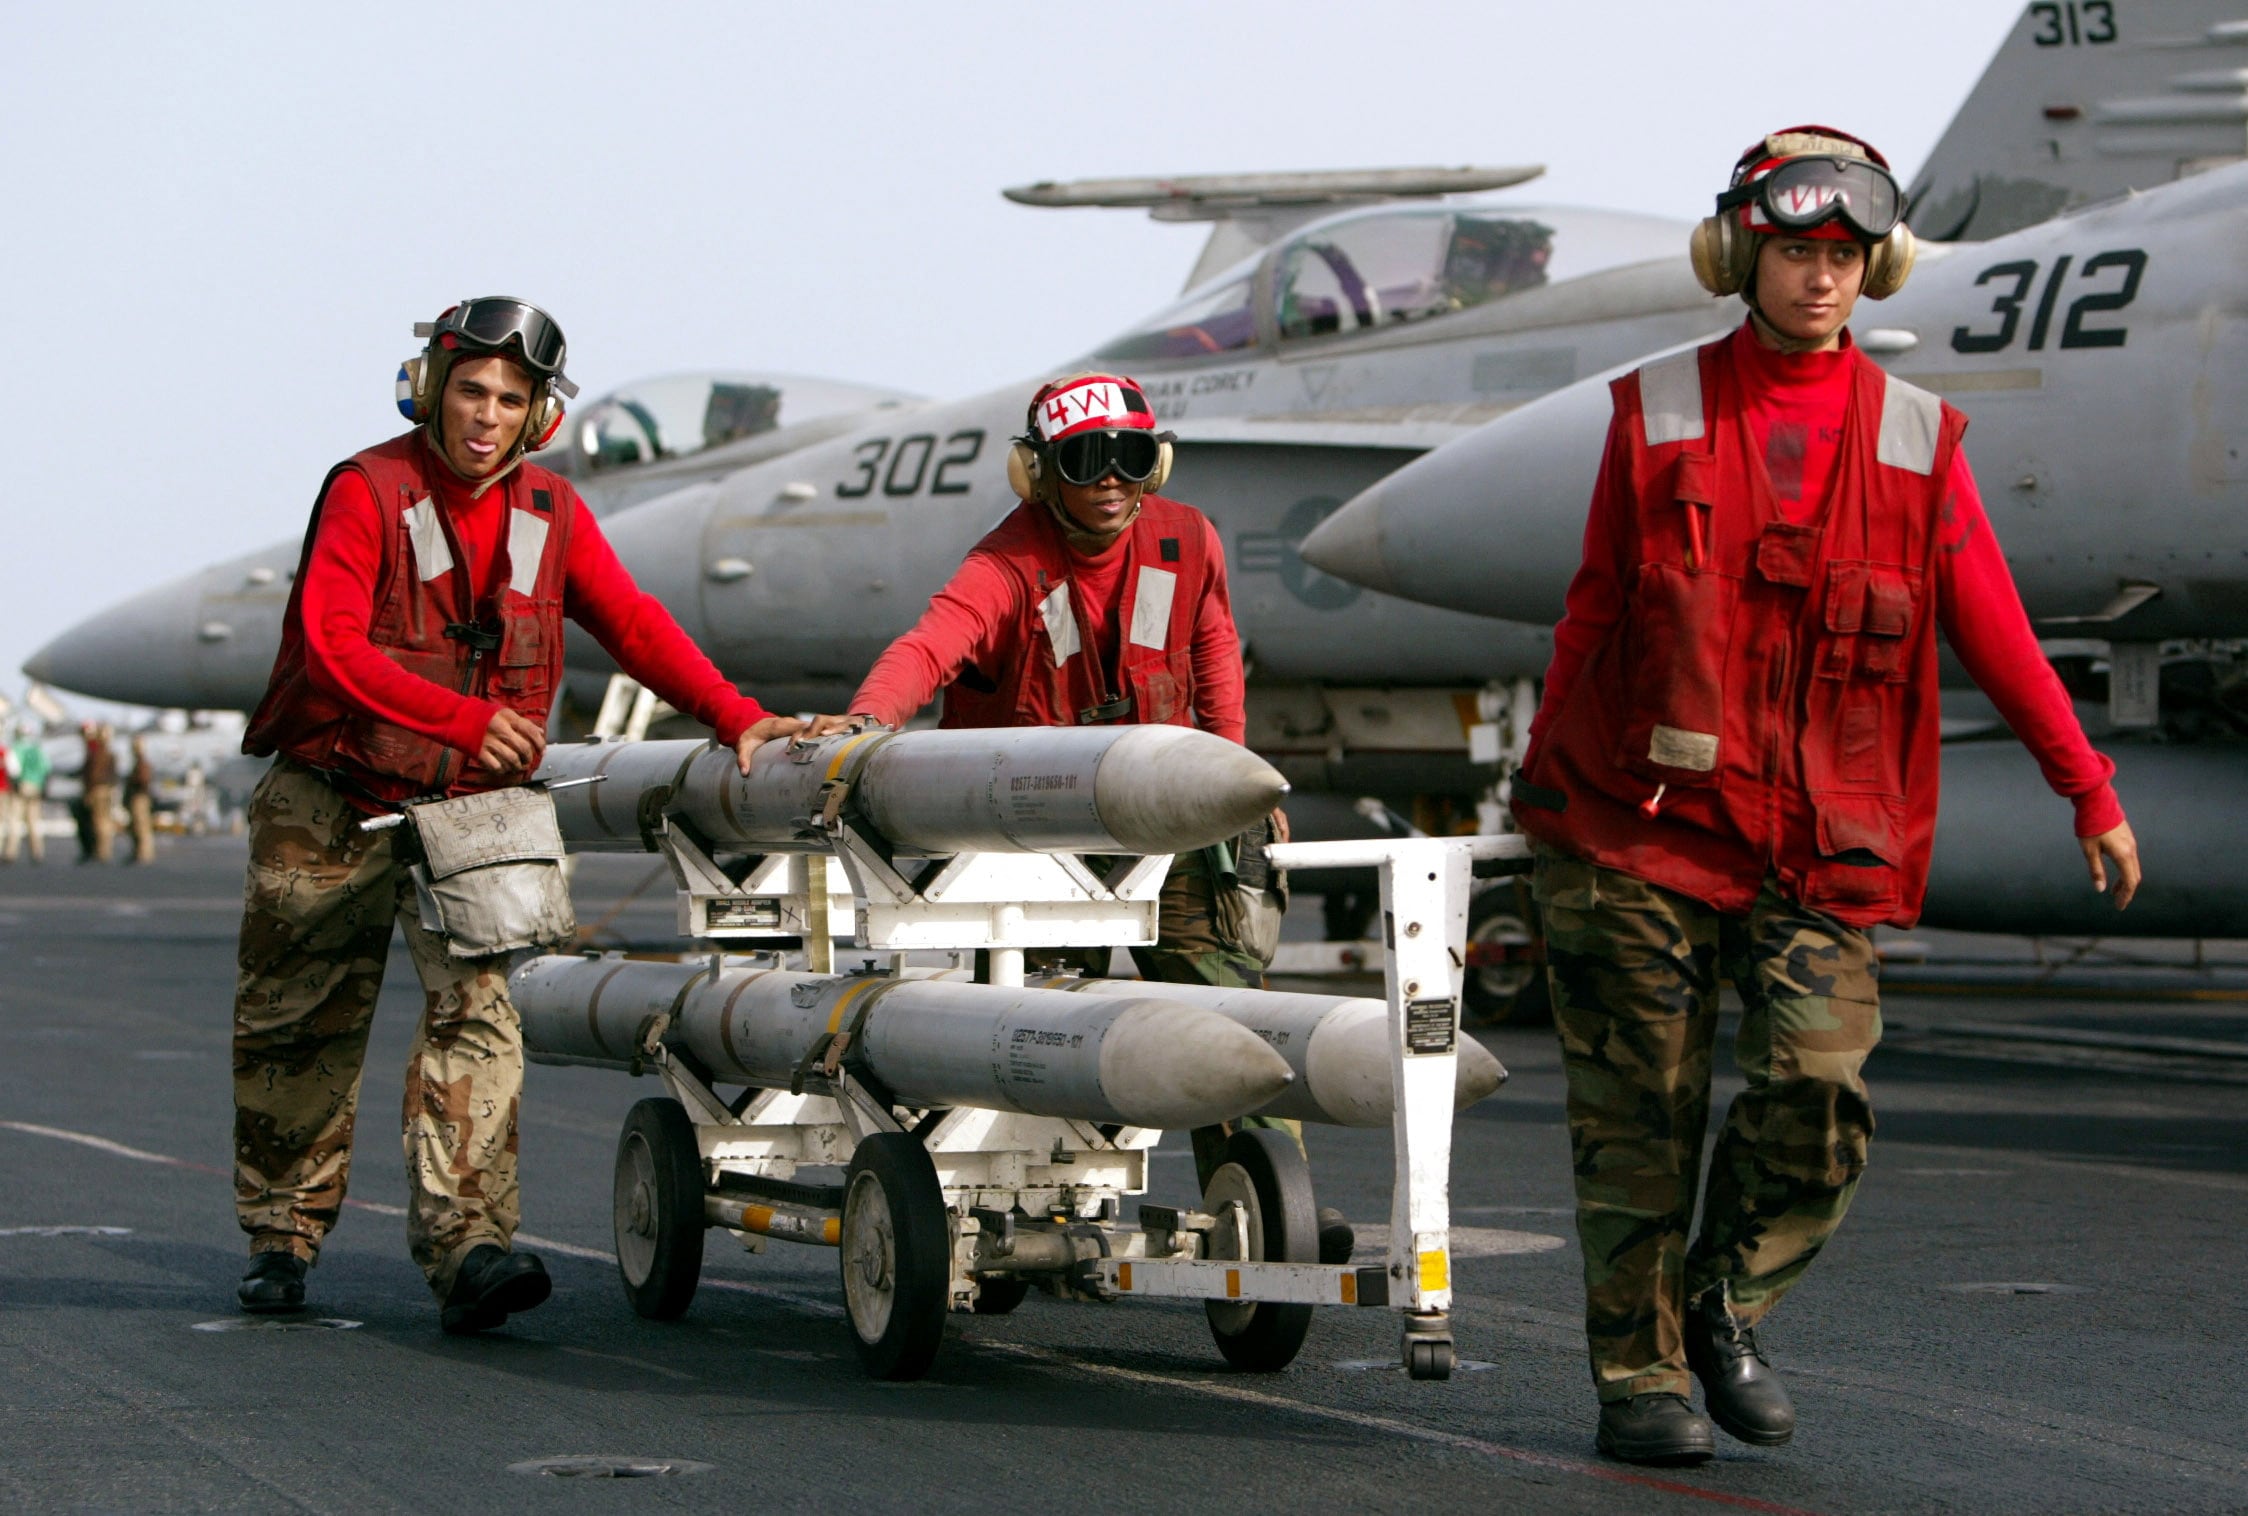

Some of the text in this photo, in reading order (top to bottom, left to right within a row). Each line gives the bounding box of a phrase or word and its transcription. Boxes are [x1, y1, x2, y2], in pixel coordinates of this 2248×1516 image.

[2030, 1, 2117, 45] 313
[1951, 248, 2148, 353] 312
[1046, 385, 1110, 426] 4W
[835, 428, 986, 497] 302
